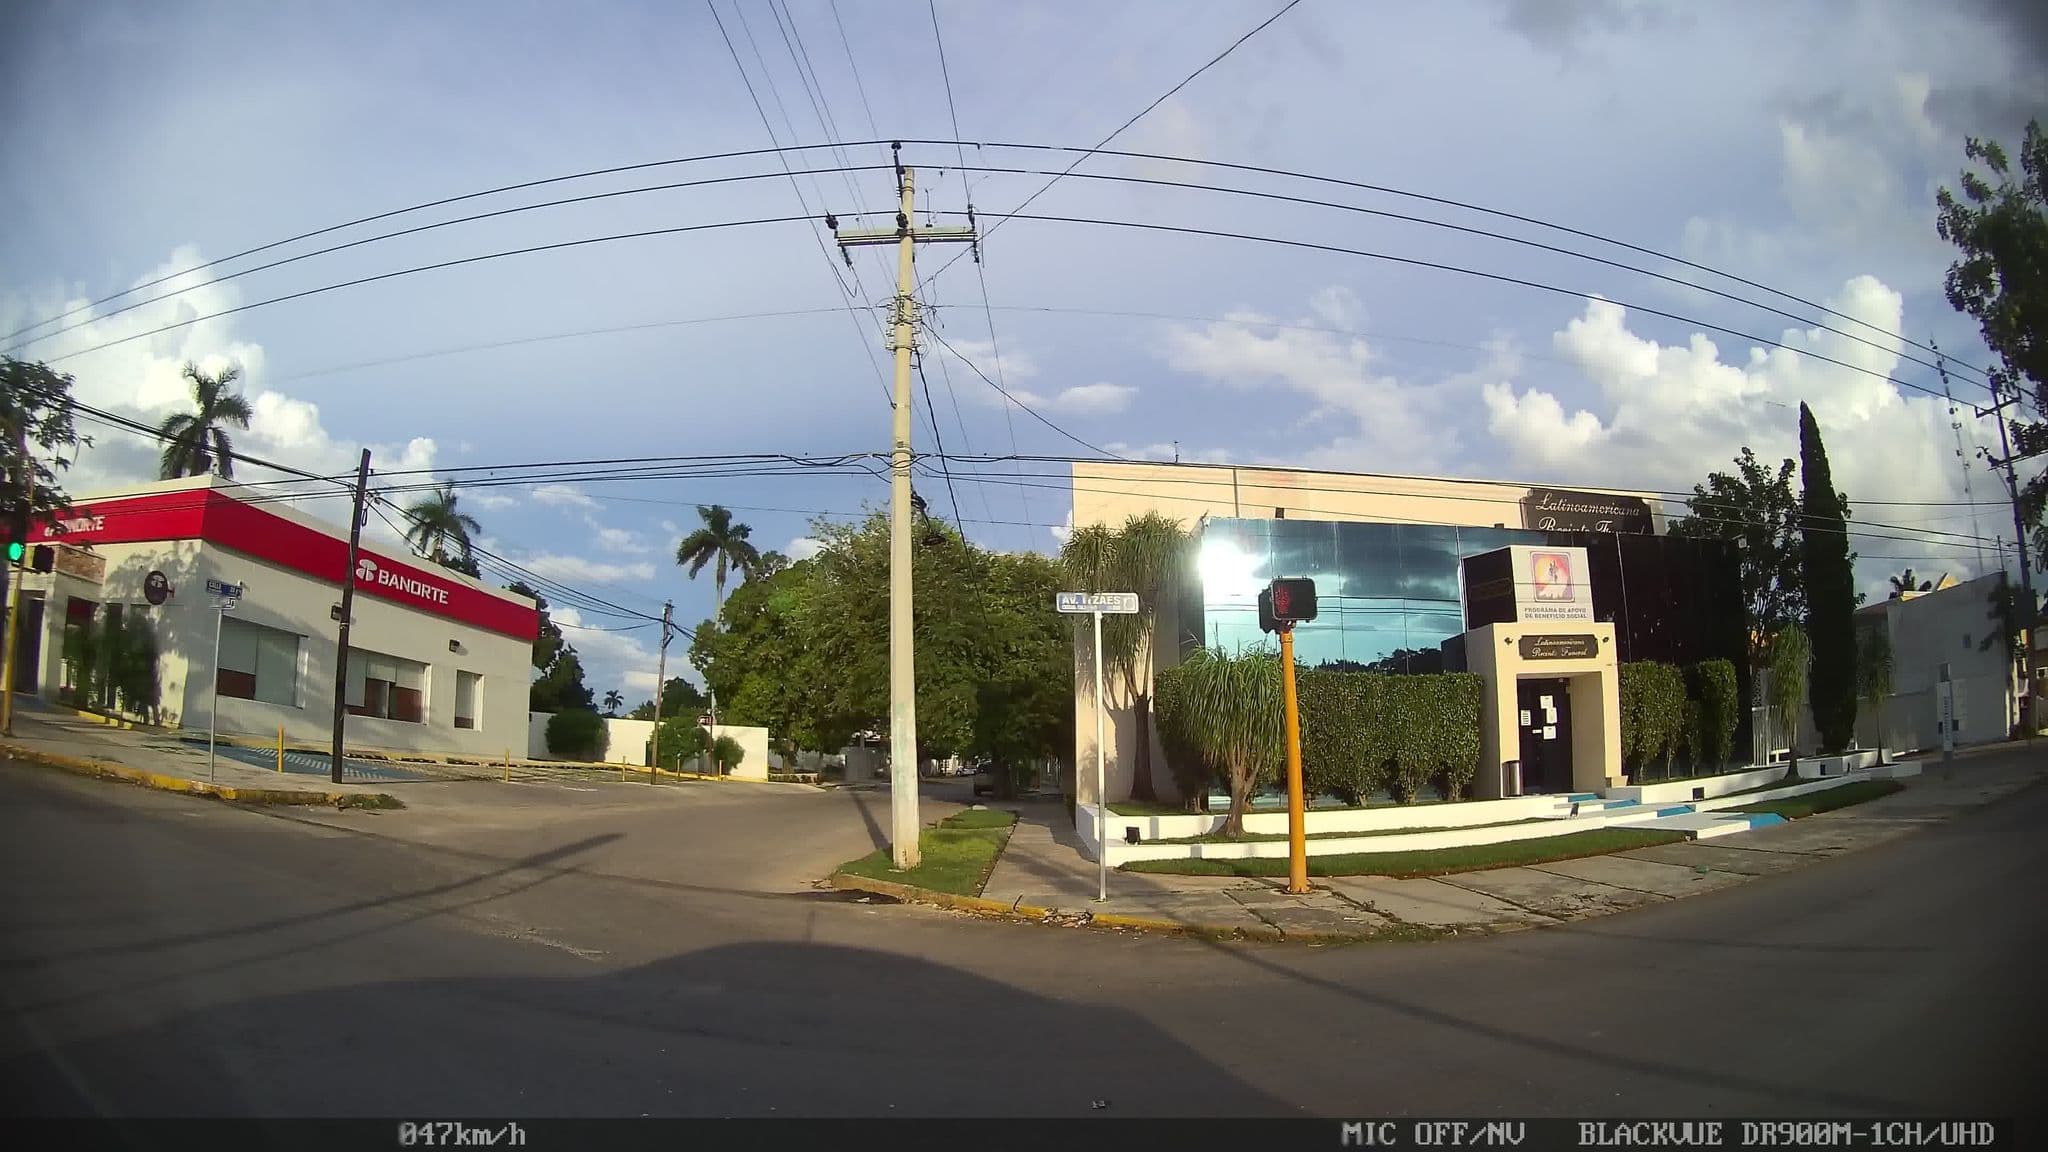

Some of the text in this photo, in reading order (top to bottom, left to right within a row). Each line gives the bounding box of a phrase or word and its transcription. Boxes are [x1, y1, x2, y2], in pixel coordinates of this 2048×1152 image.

[1535, 492, 1640, 517] Latinoamericana
[378, 569, 449, 605] BANORTE
[1062, 595, 1079, 605] AV.
